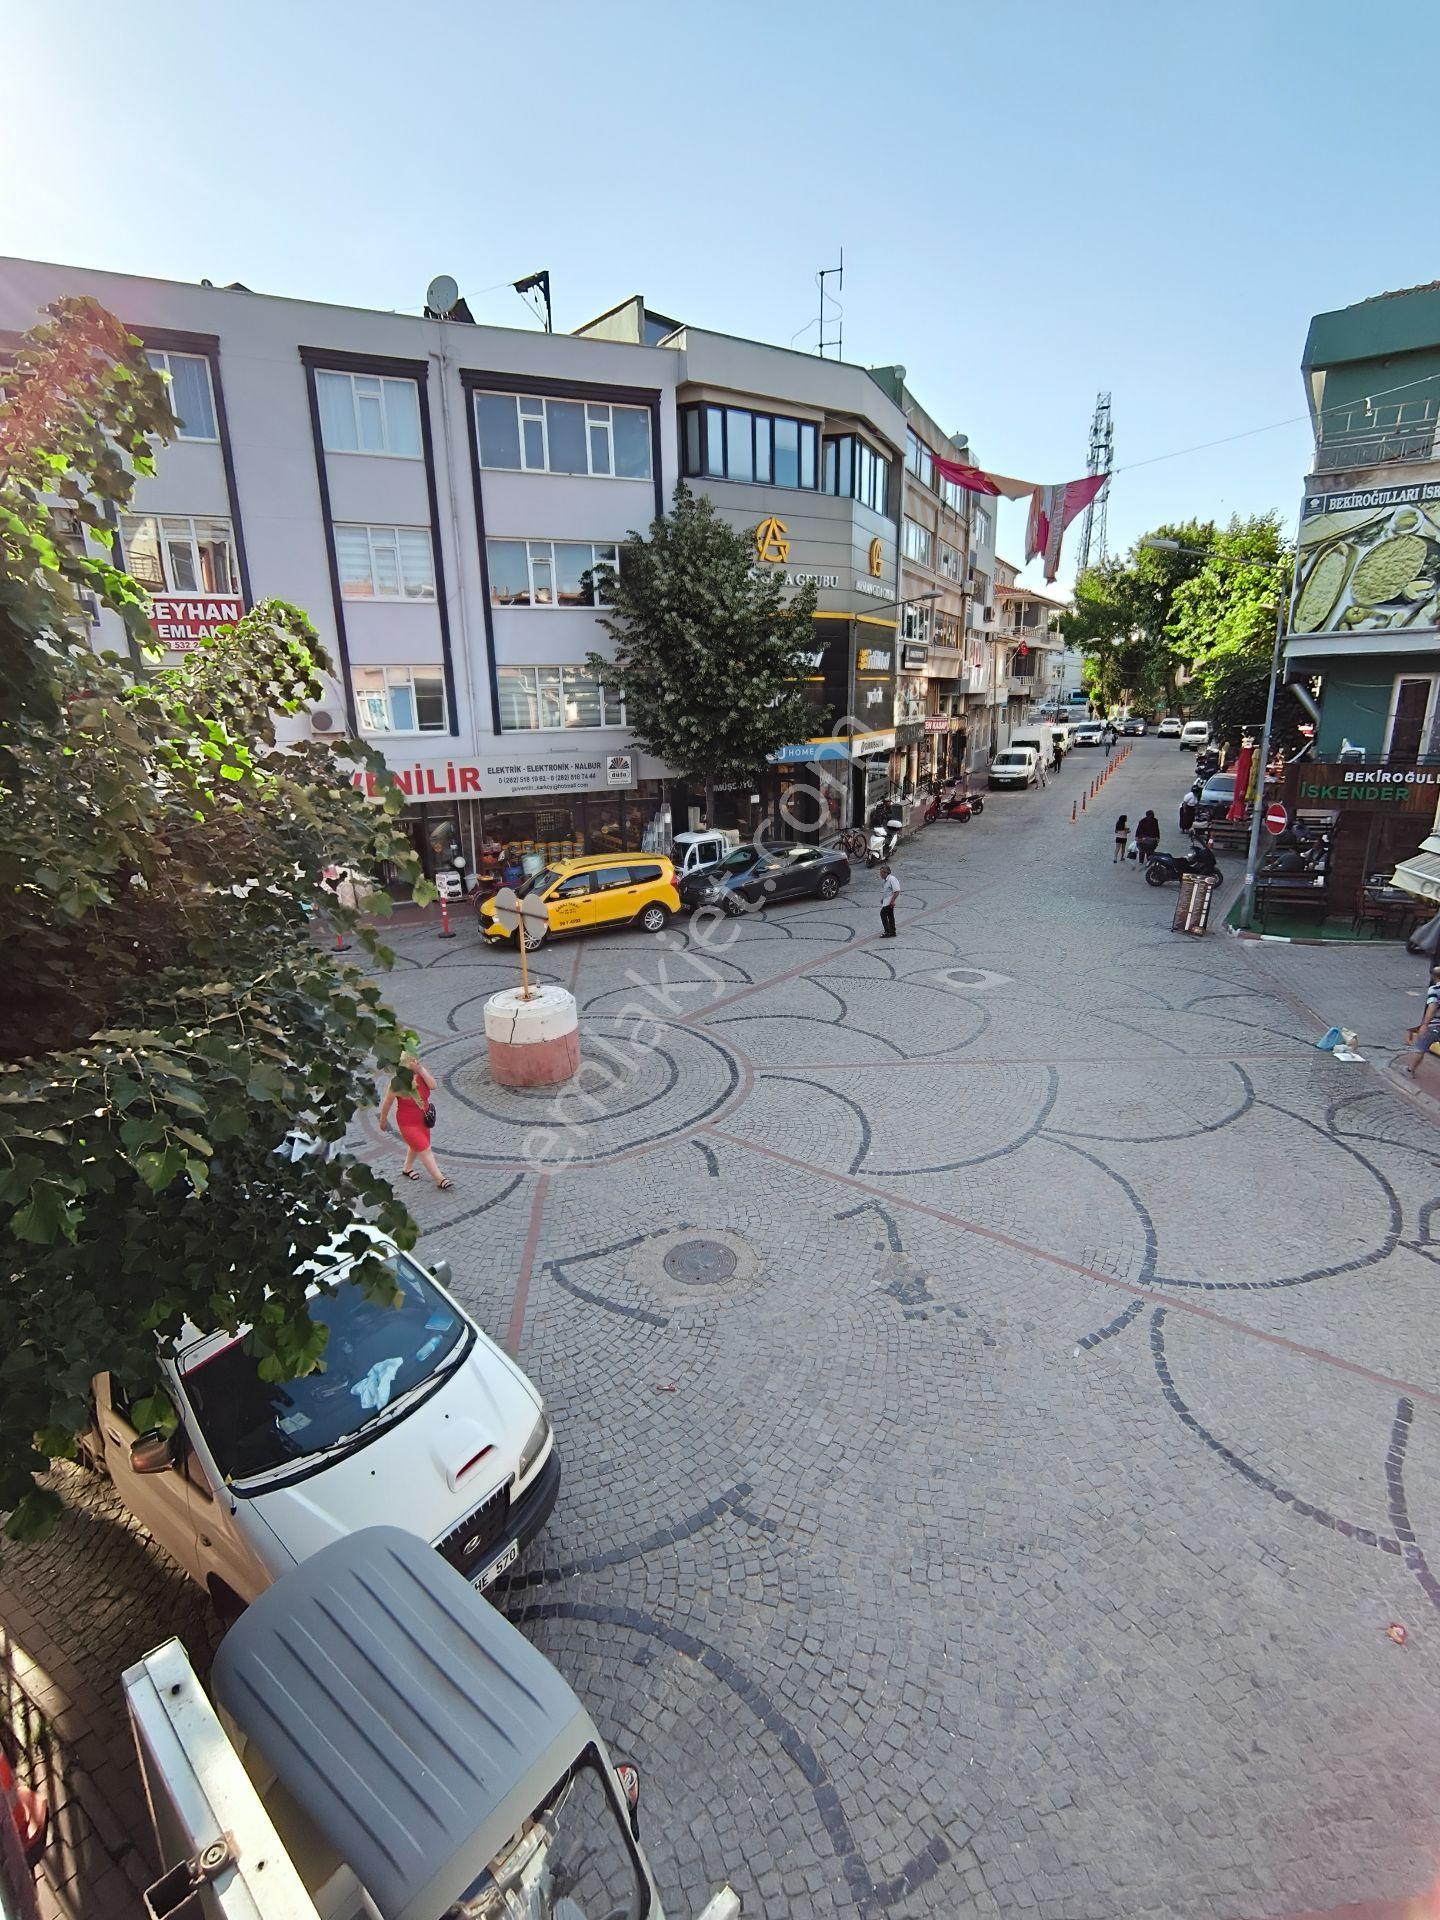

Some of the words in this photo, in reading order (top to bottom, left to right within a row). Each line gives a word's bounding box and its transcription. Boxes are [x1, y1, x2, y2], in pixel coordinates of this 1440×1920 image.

[1328, 487, 1420, 511] BEKİROĞULLARI
[174, 641, 191, 649] 532
[788, 748, 815, 757] HOME
[487, 765, 521, 774] ELEKTRİK
[527, 762, 569, 773] ELEKTRONİK
[574, 762, 601, 770] NALBUR
[1301, 781, 1409, 801] İSKENDER
[496, 1548, 516, 1574] 570
